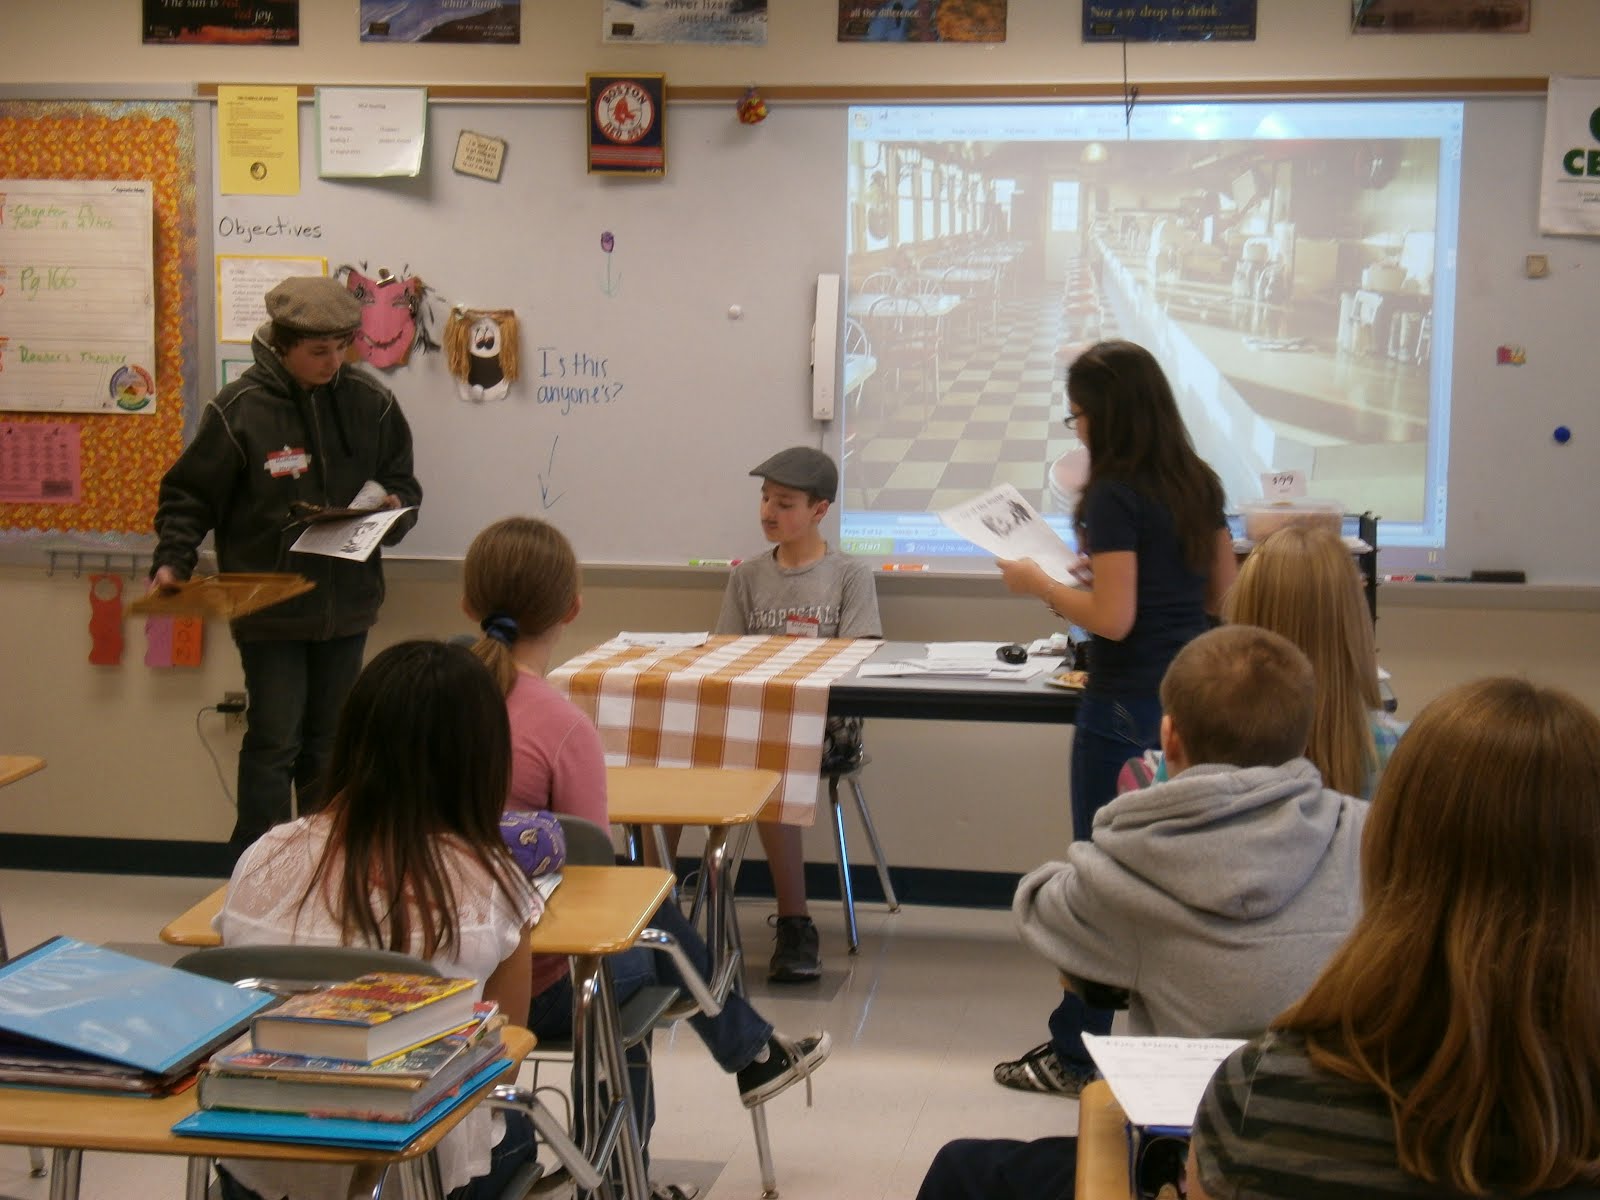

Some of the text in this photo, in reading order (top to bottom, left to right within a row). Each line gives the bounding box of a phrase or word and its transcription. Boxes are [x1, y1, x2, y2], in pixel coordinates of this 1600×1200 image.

[186, 0, 206, 8] sun
[849, 8, 861, 17] all
[863, 8, 876, 17] the
[1090, 6, 1114, 17] Nor
[1140, 5, 1168, 21] drop
[1172, 8, 1184, 17] to
[602, 85, 648, 105] BOSTON
[219, 215, 323, 243] Objectives
[572, 353, 608, 378] this
[537, 382, 624, 416] anyone's?
